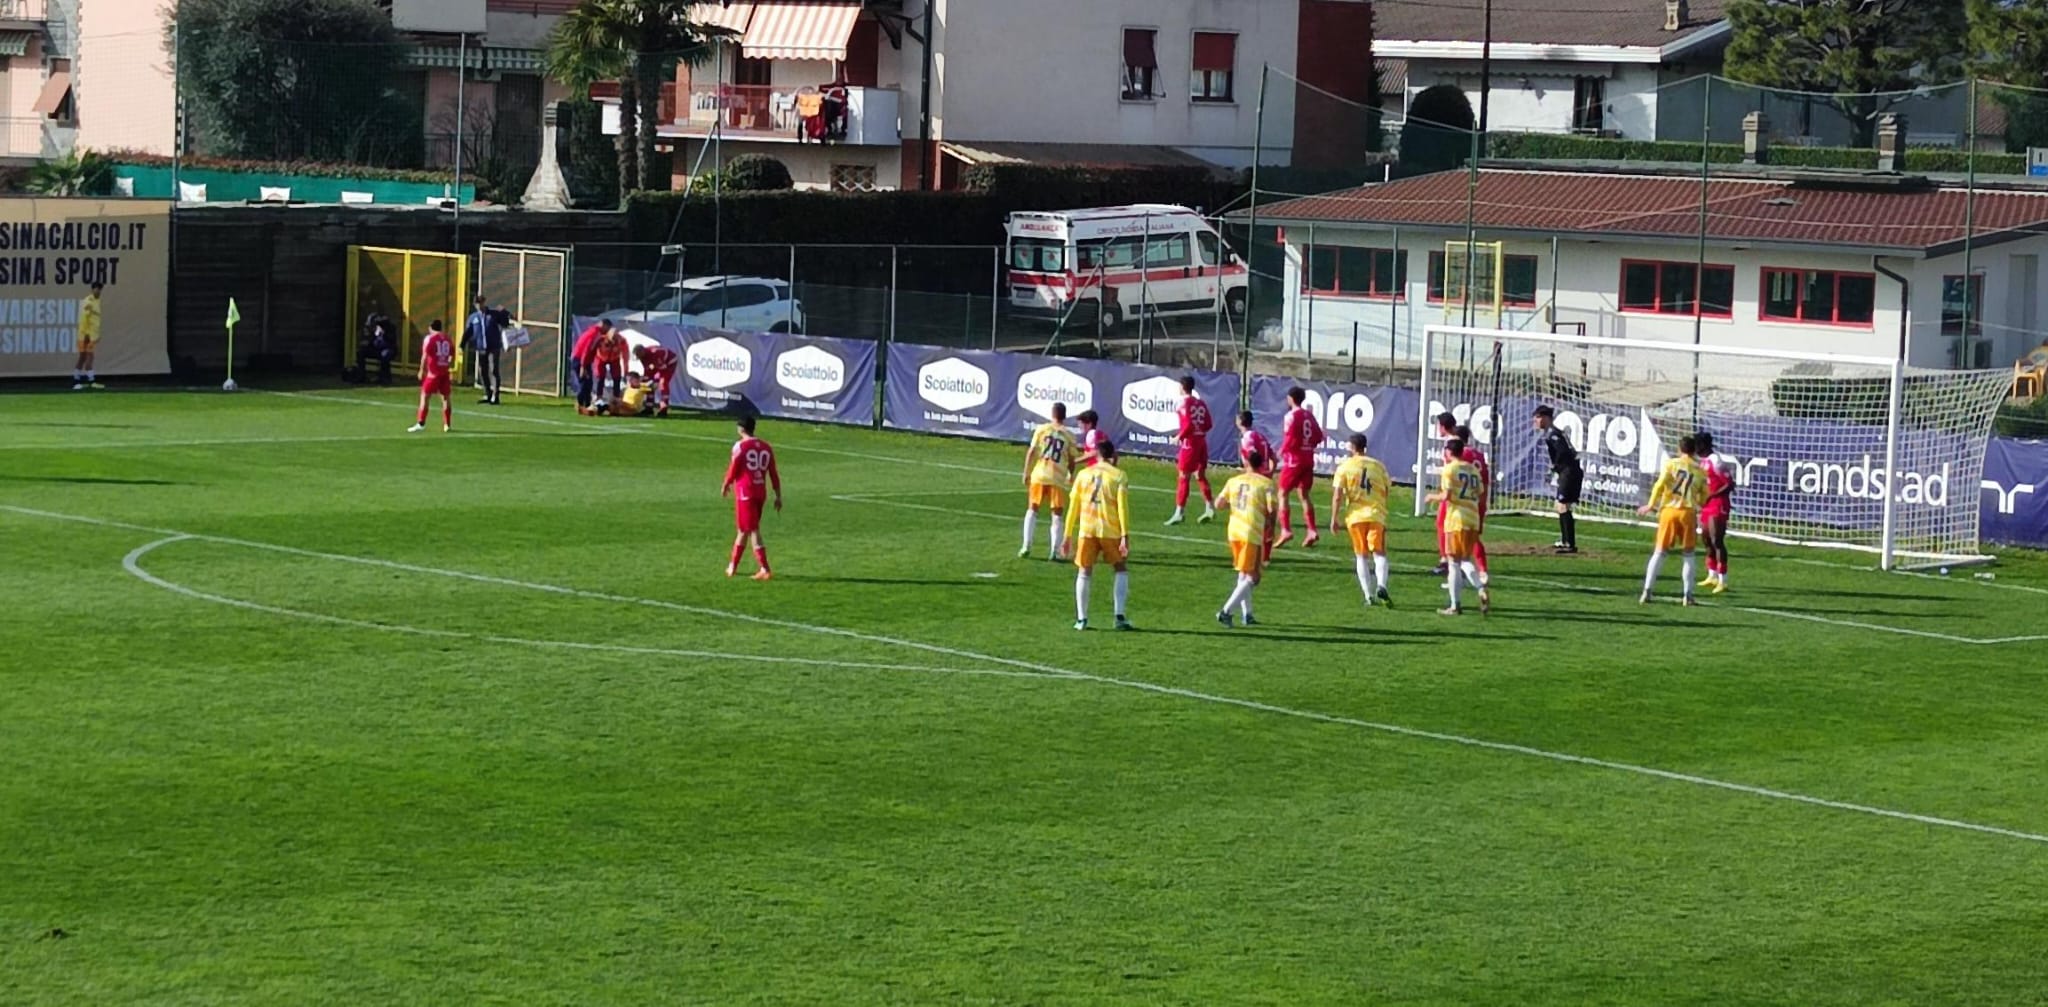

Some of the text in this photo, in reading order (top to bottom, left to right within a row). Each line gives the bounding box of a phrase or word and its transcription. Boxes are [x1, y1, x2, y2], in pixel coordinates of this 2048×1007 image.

[0, 222, 146, 250] SINACALCIO.IT
[0, 257, 119, 285] SINA SPORT
[692, 353, 746, 372] Scoiattolo
[782, 362, 838, 382] Scoiattolo
[924, 375, 983, 395] Scoiattolo
[1024, 383, 1086, 405] Scoiattolo
[1129, 393, 1178, 413] Scoiatt
[746, 449, 770, 471] 90
[1042, 435, 1065, 464] 28
[1360, 467, 1373, 496] 4
